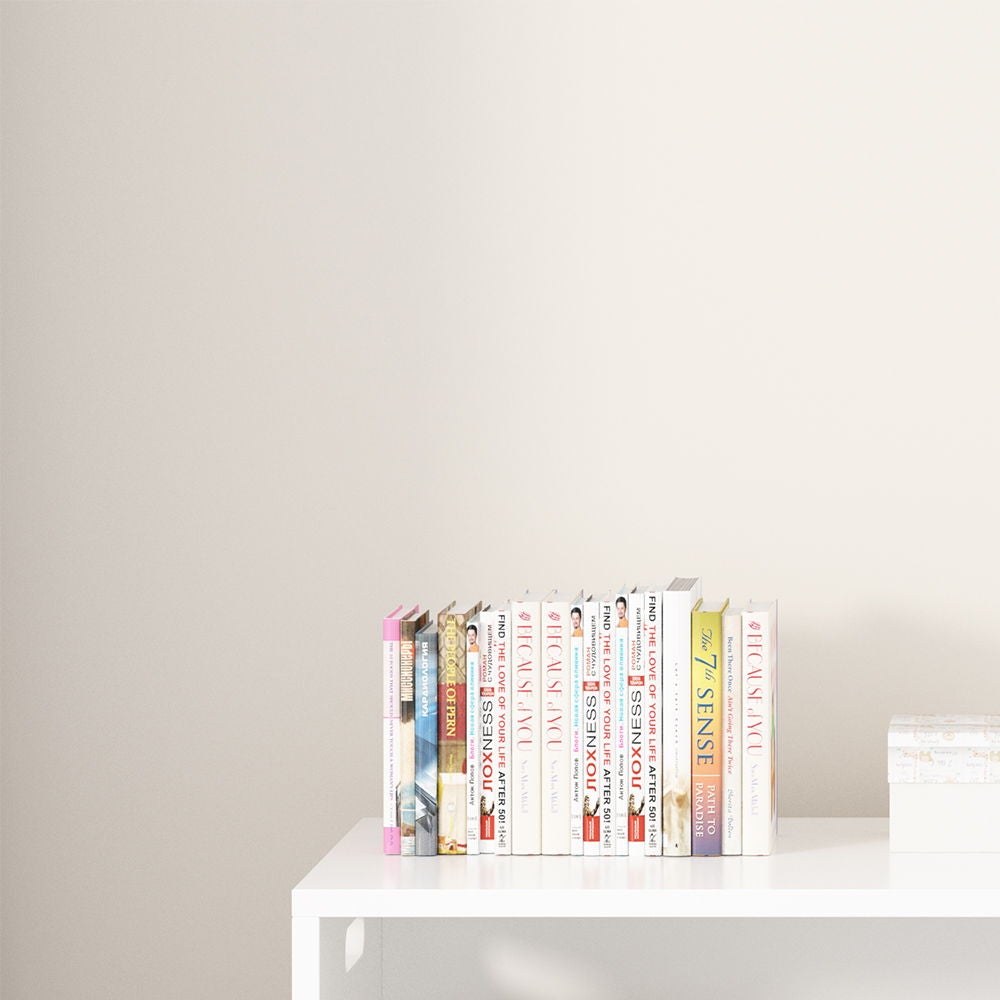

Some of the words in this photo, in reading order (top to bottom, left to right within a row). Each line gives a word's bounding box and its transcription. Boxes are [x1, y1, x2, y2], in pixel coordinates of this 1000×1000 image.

[648, 596, 656, 622] FIND
[446, 618, 456, 643] THE
[498, 614, 506, 638] FIND
[648, 625, 656, 646] THE
[701, 628, 713, 651] The
[446, 644, 456, 686] PEOPLE
[498, 642, 506, 662] THE
[517, 625, 533, 698] BECAUSE
[547, 625, 562, 698] BECAUSE
[648, 650, 656, 680] LOVE
[421, 642, 429, 717] КАРДИОЛОГИЯ
[498, 665, 506, 692] LOVE
[694, 654, 717, 680] 7th
[746, 634, 763, 704] BECAUSE
[446, 688, 456, 706] OF
[498, 696, 506, 710] OF
[604, 690, 611, 706] OF
[648, 684, 656, 699] OF
[446, 706, 456, 736] PERN
[498, 714, 506, 743] YOUR
[648, 702, 656, 734] YOUR
[696, 688, 714, 766] SENSE
[726, 714, 734, 734] Going
[517, 716, 533, 752] YOU
[547, 716, 562, 752] YOU
[746, 721, 763, 756] YOU
[498, 746, 506, 768] LIFE
[648, 738, 656, 762] LIFE
[498, 772, 506, 806] AFTER
[648, 766, 656, 803] AFTER
[696, 782, 704, 838] PARADISE
[707, 785, 716, 814] PATH
[498, 809, 506, 824] 50!
[648, 806, 656, 822] 50!
[707, 818, 716, 835] TO
